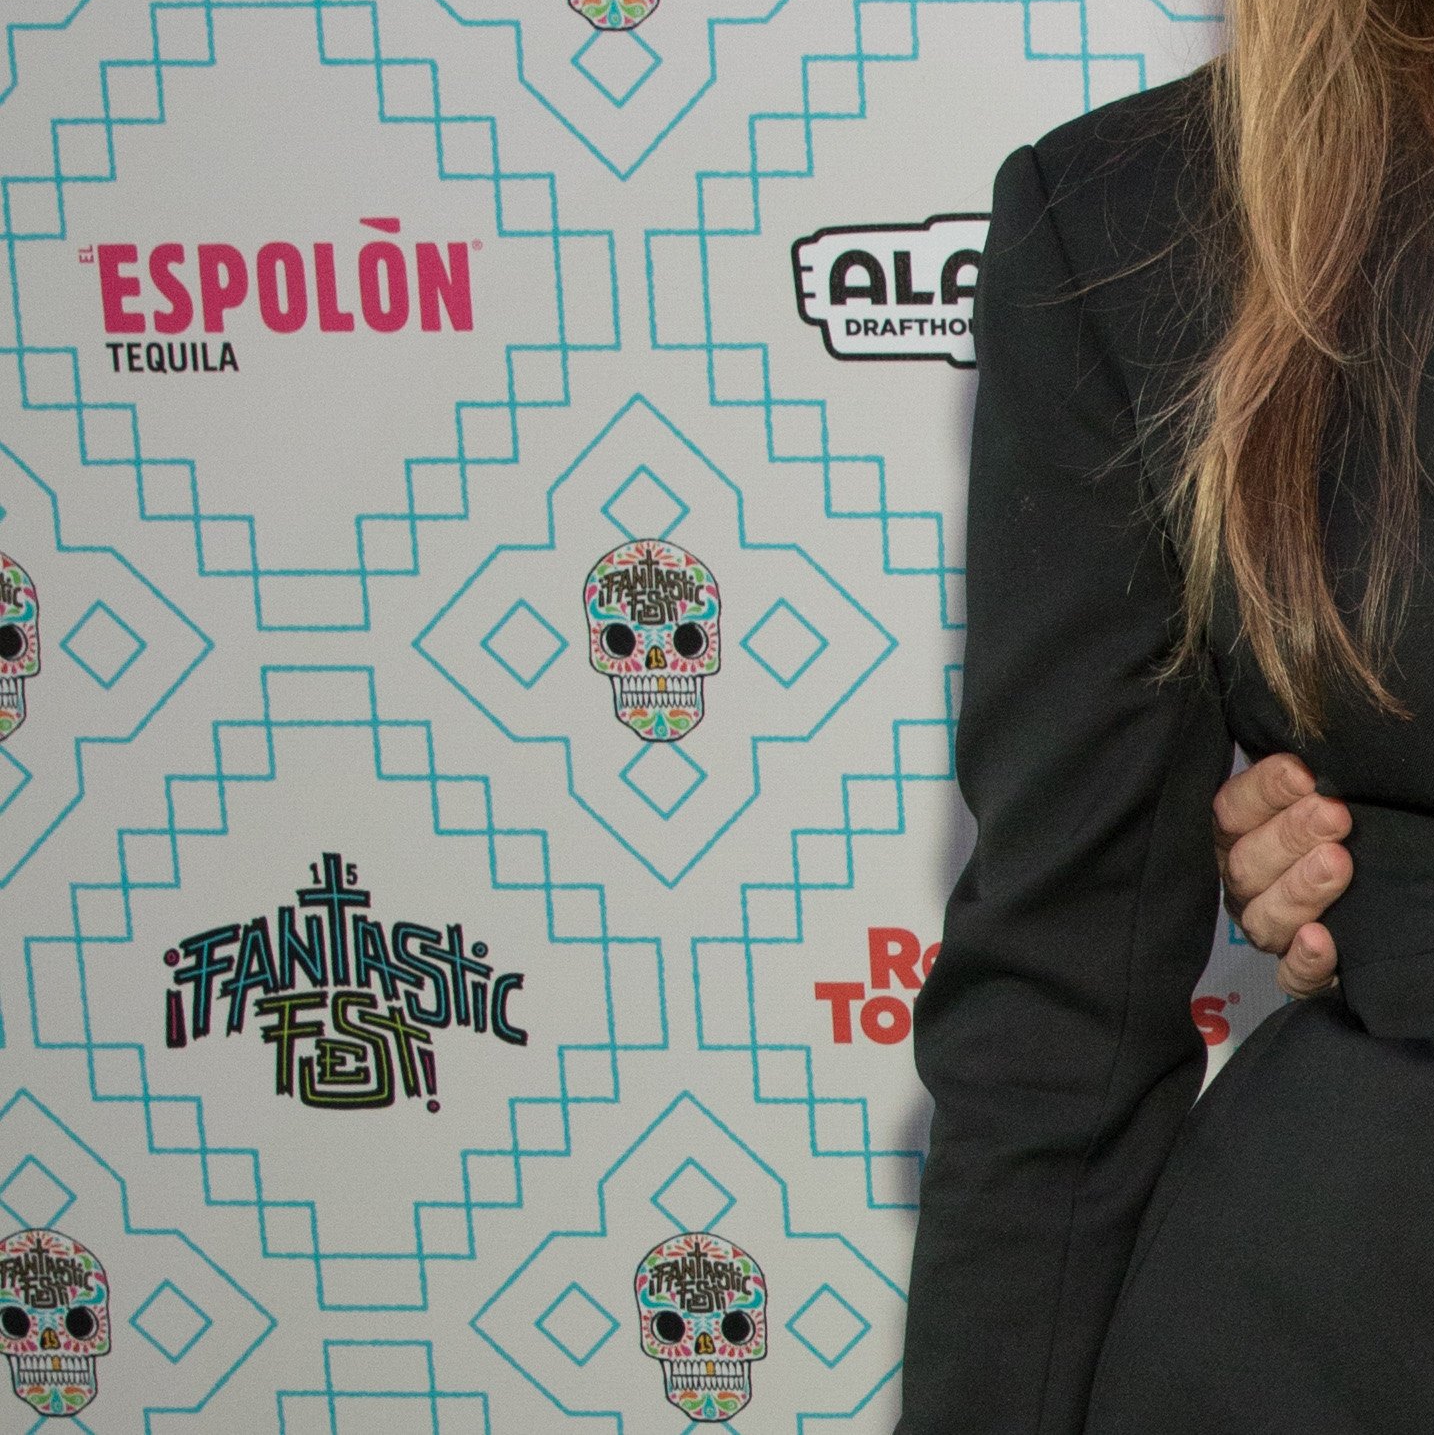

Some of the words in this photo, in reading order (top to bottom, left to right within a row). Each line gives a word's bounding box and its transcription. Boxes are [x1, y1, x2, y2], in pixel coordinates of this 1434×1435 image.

[829, 249, 982, 306] ALA
[845, 318, 974, 337] DRAFTHO
[106, 342, 240, 374] TEQUILA
